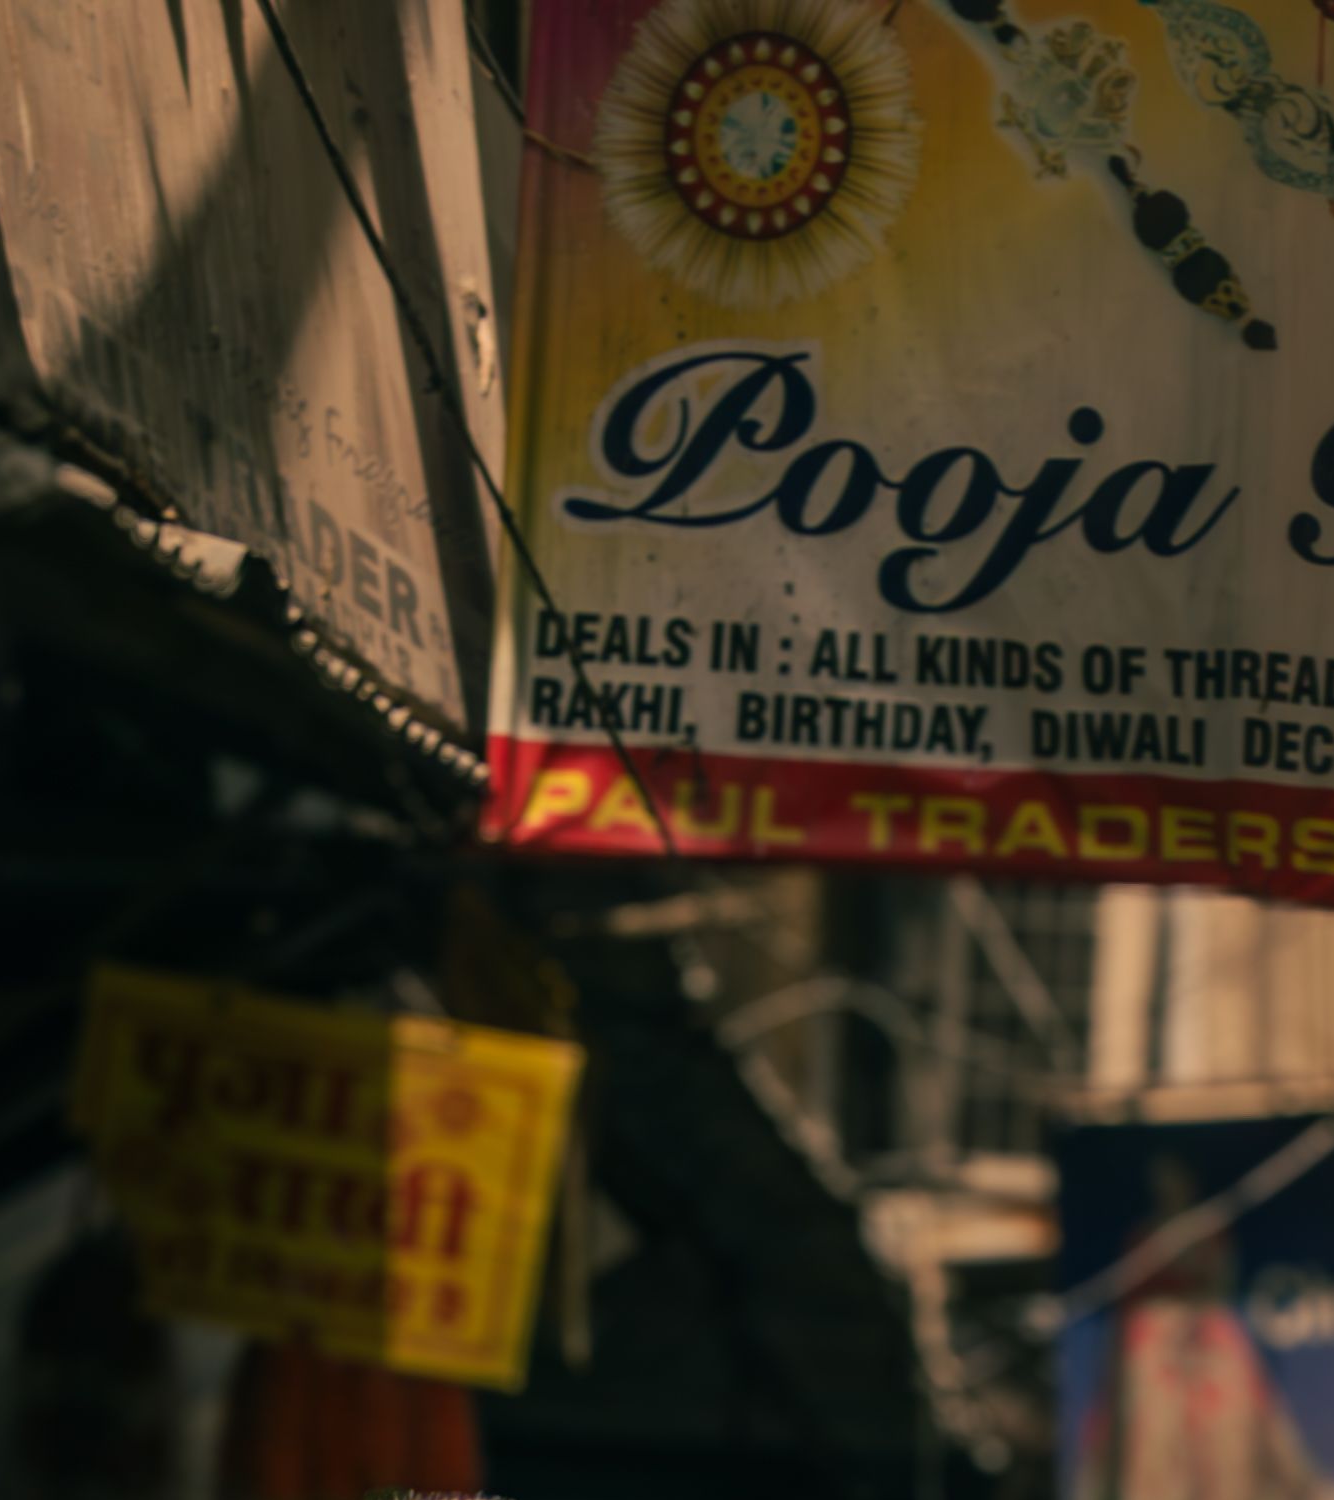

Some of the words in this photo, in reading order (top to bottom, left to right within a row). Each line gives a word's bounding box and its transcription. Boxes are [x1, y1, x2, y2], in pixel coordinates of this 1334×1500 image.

[563, 349, 1241, 614] Pooja
[535, 610, 692, 671] DEALS
[710, 621, 760, 673] IN
[809, 630, 897, 685] ALL
[916, 636, 1064, 693] KINDS
[1082, 645, 1147, 697] OF
[530, 677, 697, 745] RAKHI,
[737, 692, 993, 764] BIRTHDAY,
[1030, 709, 1207, 767] DIWALI
[522, 769, 805, 848] PAUL
